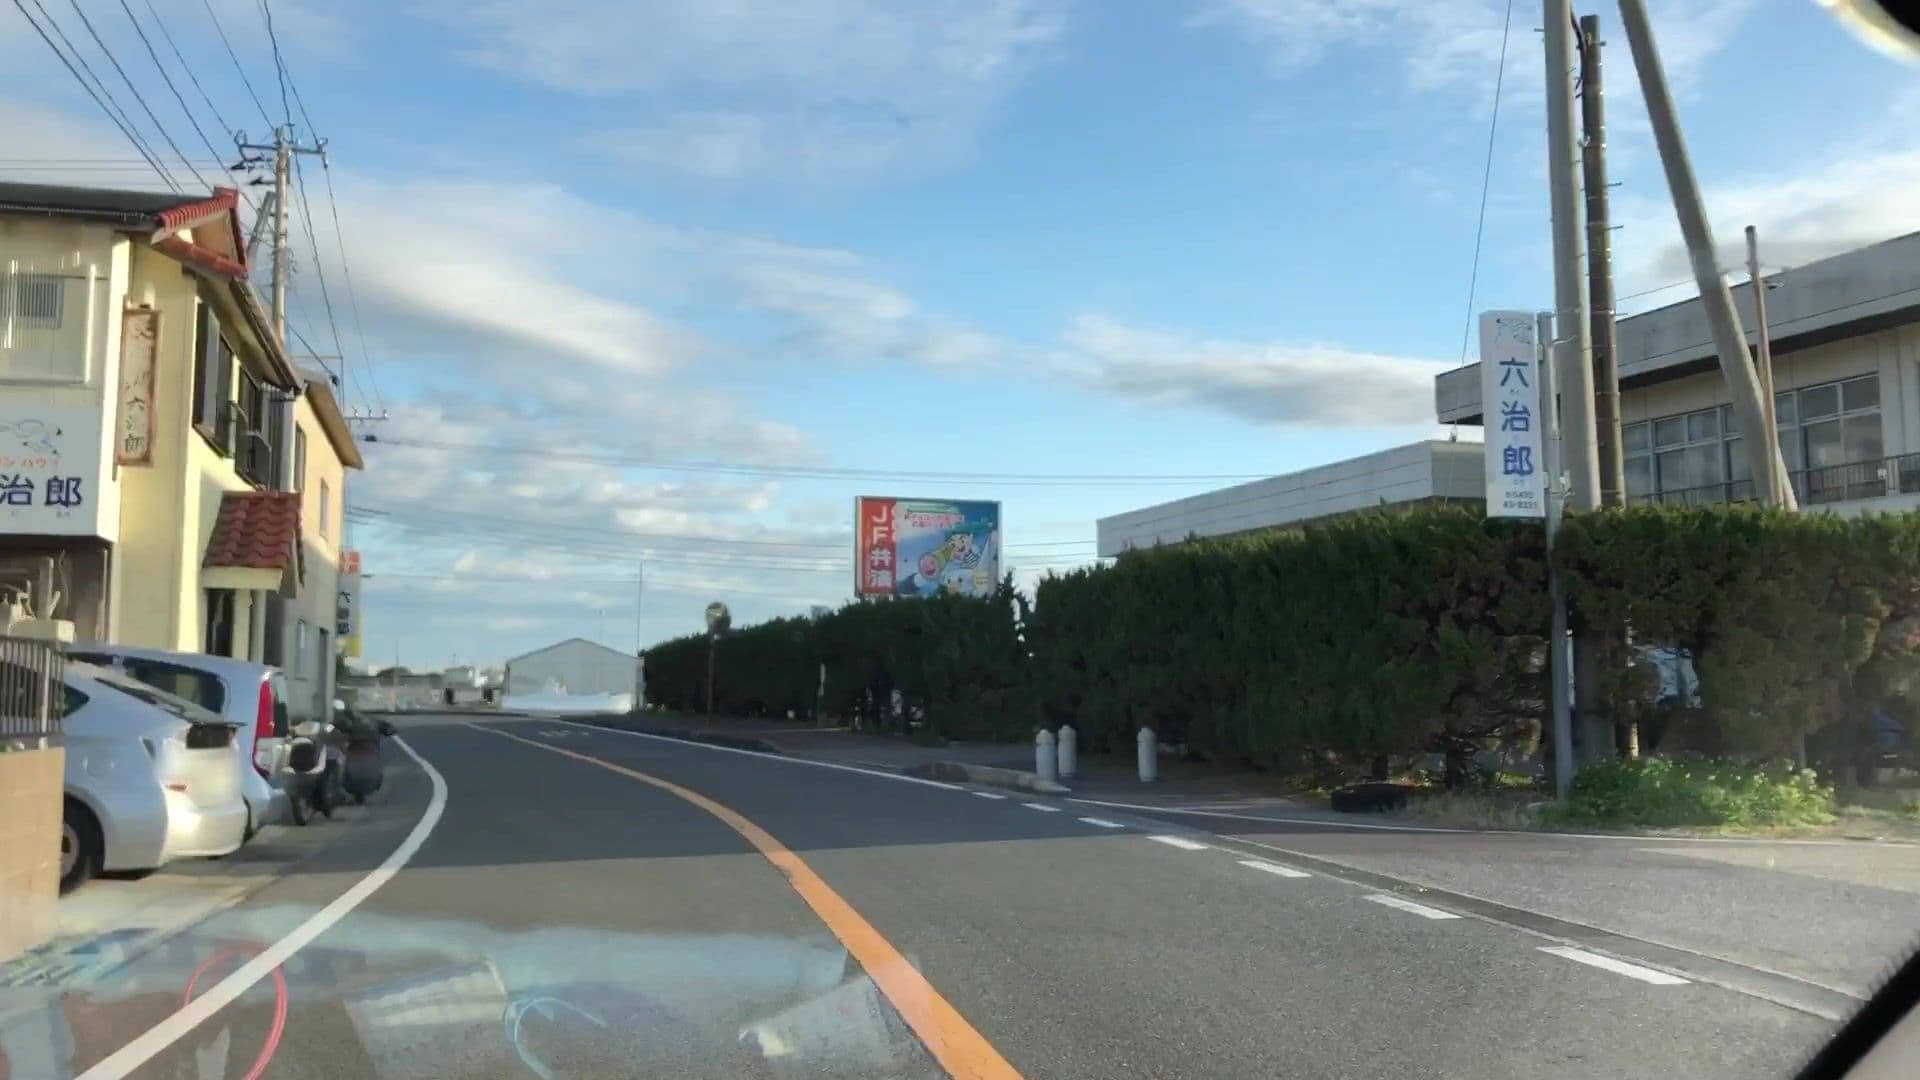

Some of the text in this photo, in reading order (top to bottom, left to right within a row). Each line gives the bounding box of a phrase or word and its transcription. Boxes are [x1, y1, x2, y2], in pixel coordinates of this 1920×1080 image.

[1499, 357, 1534, 476] 六治郎
[0, 474, 82, 508] 治郎
